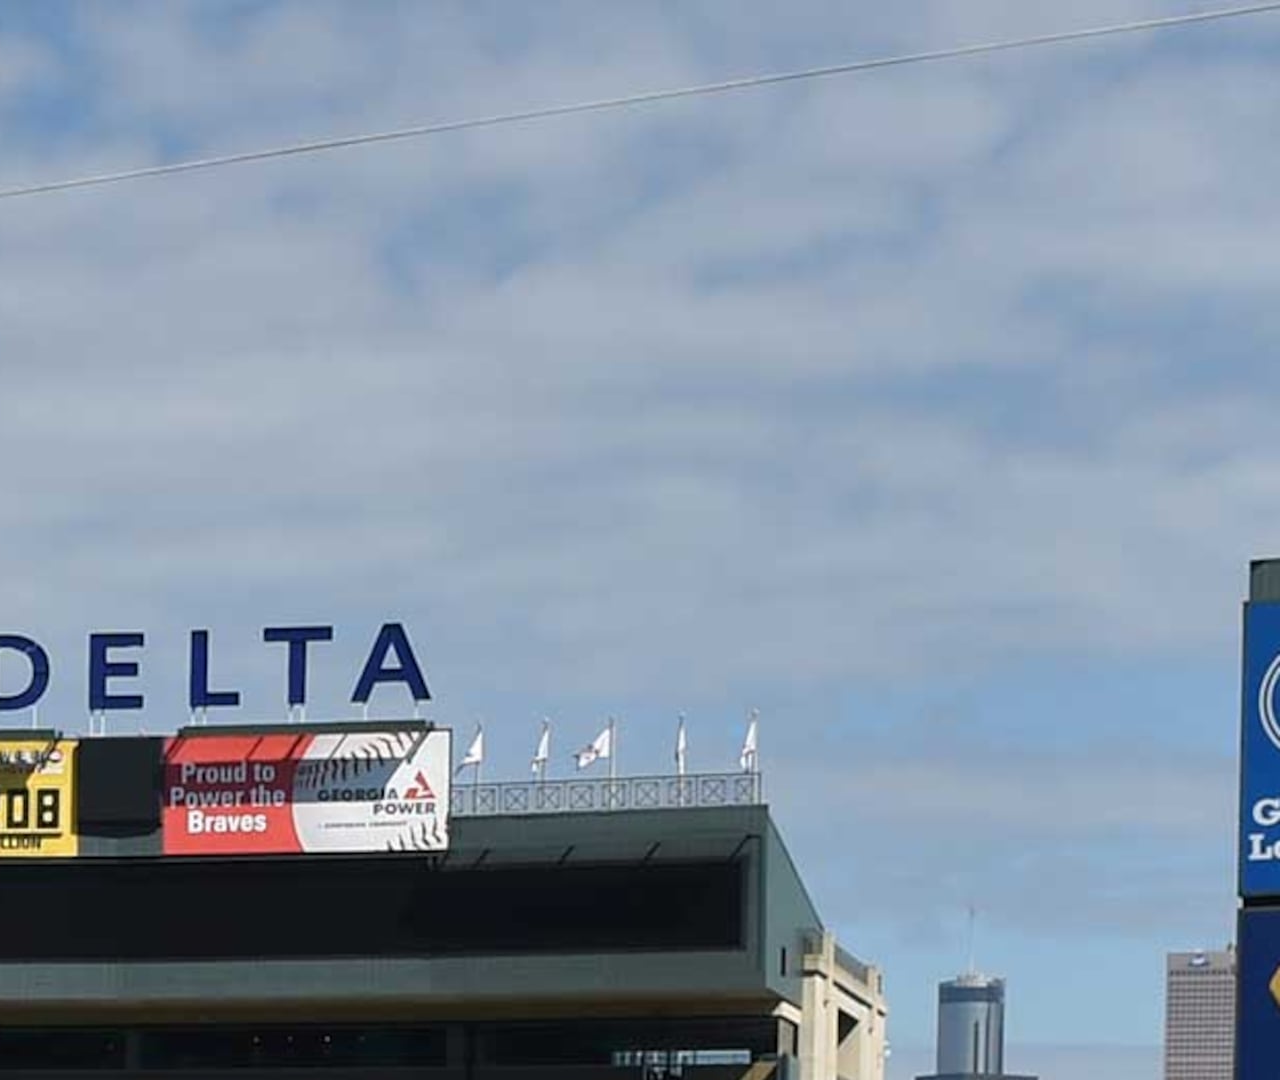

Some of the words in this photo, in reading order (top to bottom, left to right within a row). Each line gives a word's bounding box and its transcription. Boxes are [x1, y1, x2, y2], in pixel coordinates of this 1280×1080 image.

[181, 761, 240, 784] Proud
[253, 764, 276, 783] to
[170, 787, 247, 809] Power
[250, 785, 286, 808] the
[317, 787, 399, 802] GEORGIA
[373, 802, 436, 816] POWER
[188, 810, 268, 834] Braves
